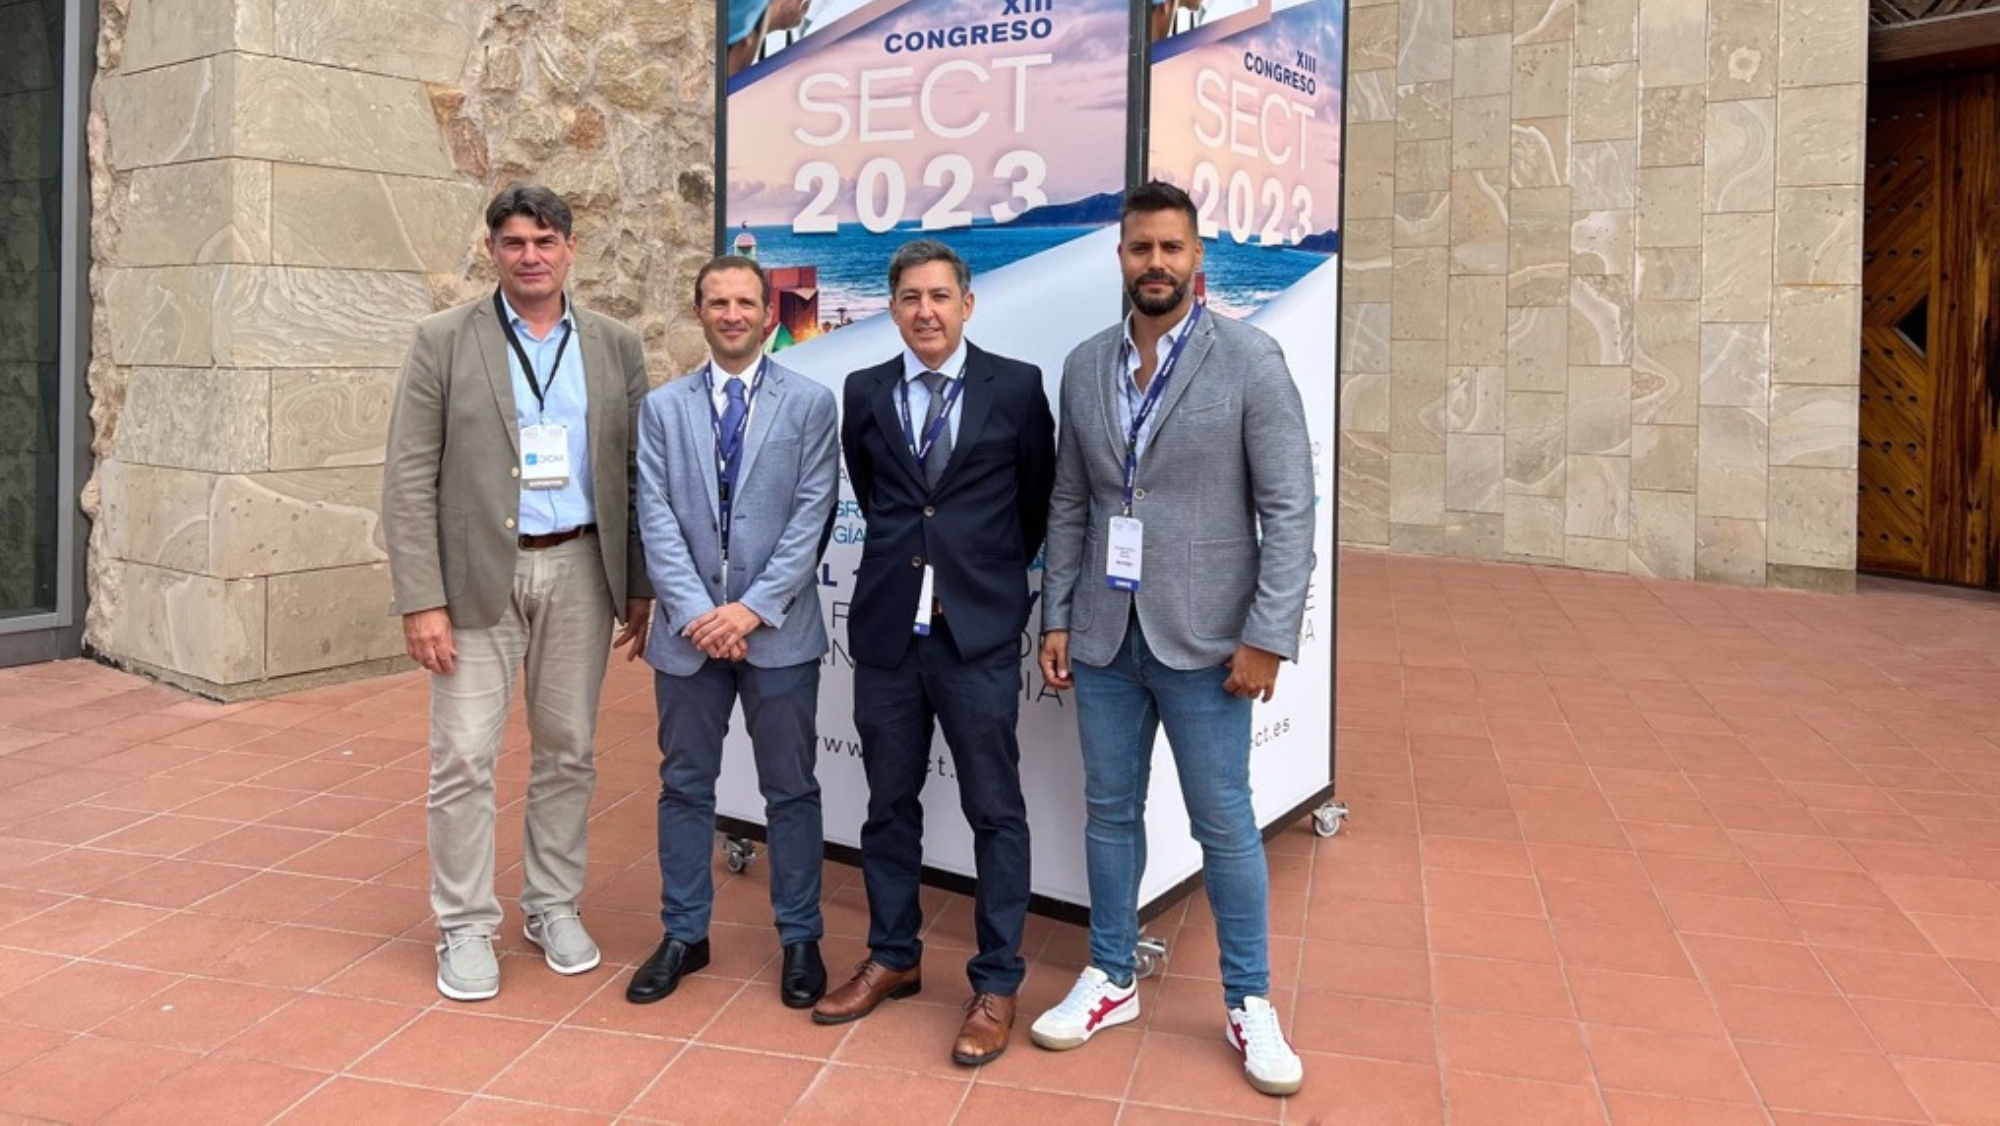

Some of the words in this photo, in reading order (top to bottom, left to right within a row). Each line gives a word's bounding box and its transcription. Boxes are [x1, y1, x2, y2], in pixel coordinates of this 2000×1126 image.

[884, 17, 1052, 54] CONGRESO
[1002, 0, 1052, 15] XIII
[1243, 52, 1316, 96] CONGRESO
[1296, 51, 1316, 74] XIII
[794, 53, 1053, 147] SECT
[1194, 68, 1316, 171] SECT
[792, 149, 1049, 234] 2023
[1192, 161, 1314, 246] 2023
